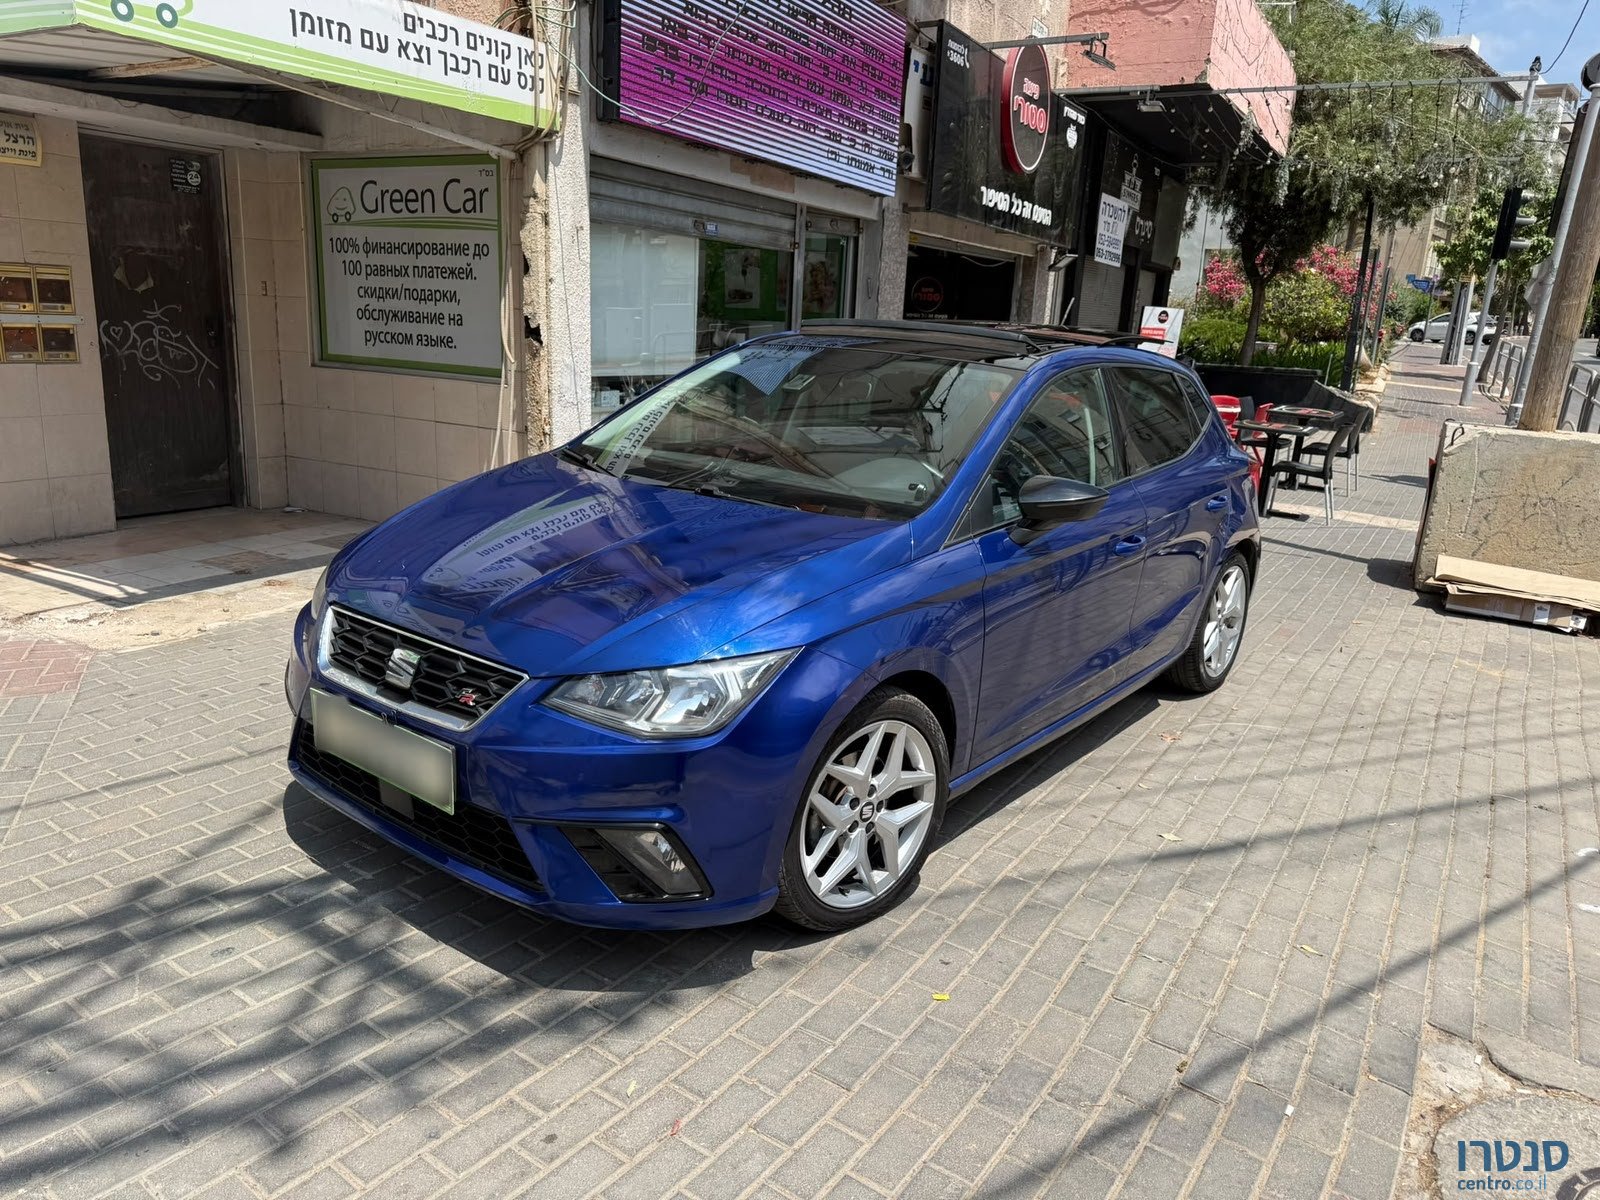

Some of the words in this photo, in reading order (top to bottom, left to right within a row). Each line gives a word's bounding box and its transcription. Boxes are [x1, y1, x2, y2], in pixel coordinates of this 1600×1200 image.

[290, 8, 351, 44] מזומן
[403, 12, 459, 46] רכבים
[360, 28, 389, 53] עם
[397, 38, 431, 65] וצא
[466, 30, 511, 64] קונים
[438, 50, 481, 78] רכבך
[488, 63, 511, 85] עם
[3, 129, 35, 146] הרצל
[0, 147, 16, 155] וייצ
[478, 168, 494, 177] בס"ד
[360, 179, 436, 215] Green
[443, 178, 489, 214] Car
[980, 186, 1010, 213] הסיפור
[1010, 192, 1023, 216] כל
[1022, 200, 1033, 219] זה
[329, 236, 360, 255] 100%
[362, 236, 470, 259] финансирование
[472, 242, 490, 260] до
[342, 259, 362, 277] 100
[365, 263, 410, 280] равных
[412, 262, 477, 281] платежей.
[357, 283, 461, 306] скидки/подарки,
[356, 303, 445, 326] обслуживание
[448, 313, 463, 327] на
[364, 329, 414, 347] русском
[416, 333, 457, 349] языке.
